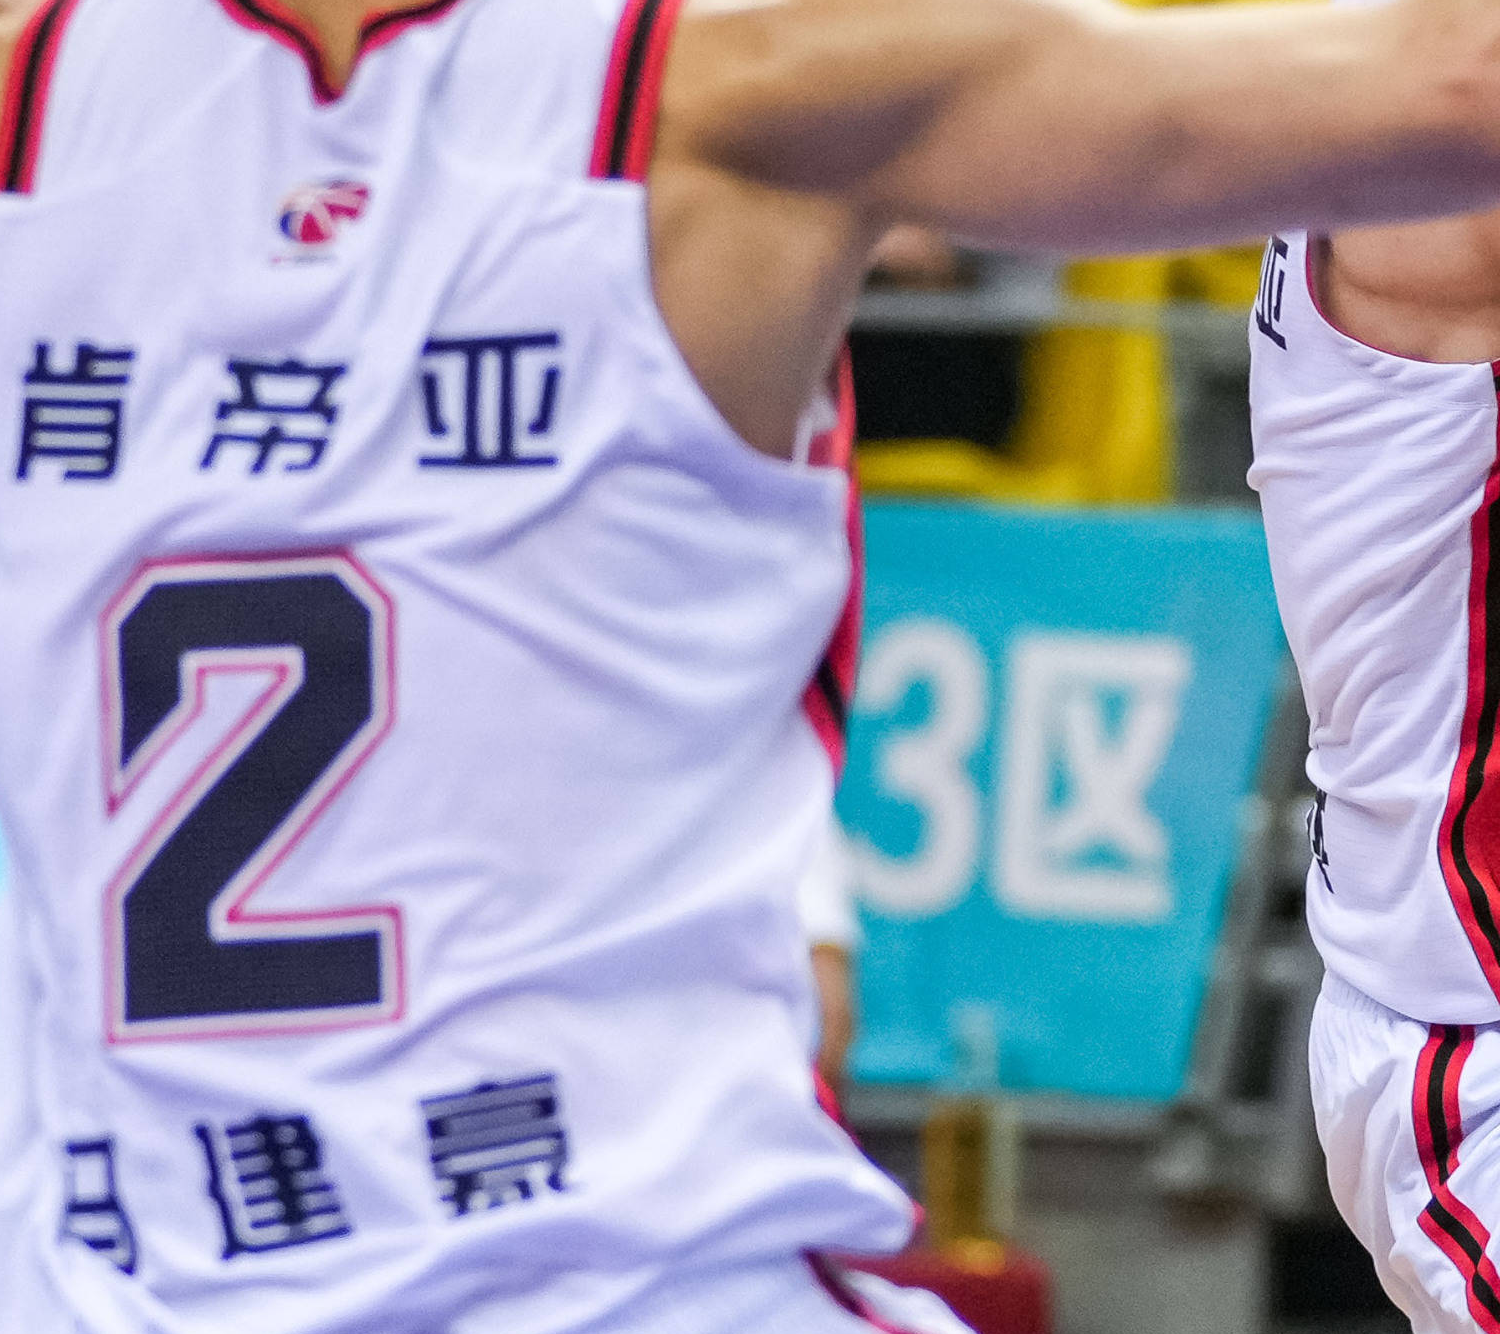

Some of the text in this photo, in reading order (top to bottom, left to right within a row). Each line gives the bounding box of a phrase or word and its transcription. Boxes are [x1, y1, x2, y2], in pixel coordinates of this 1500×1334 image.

[14, 330, 562, 483] 肯帝亚
[105, 546, 404, 1043] 2
